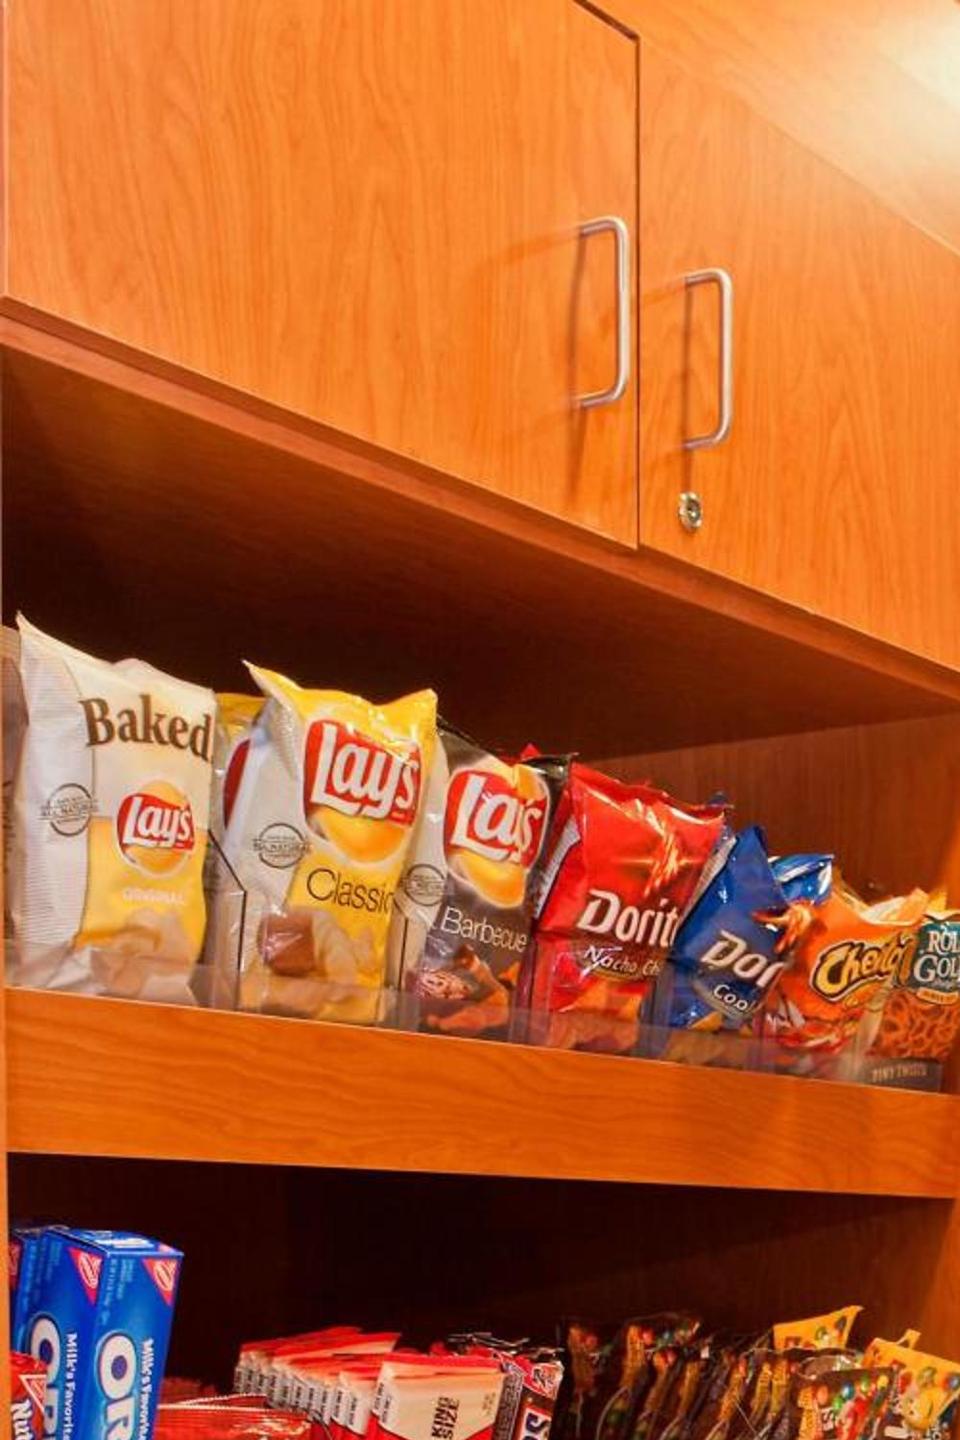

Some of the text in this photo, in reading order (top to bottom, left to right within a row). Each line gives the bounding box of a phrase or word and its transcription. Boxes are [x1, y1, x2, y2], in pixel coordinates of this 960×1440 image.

[79, 695, 213, 761] Baked
[311, 721, 420, 820] Lay's
[122, 797, 194, 850] Lay's
[306, 868, 397, 914] Classic
[441, 906, 529, 951] Barbecue
[431, 1396, 449, 1439] KING
[443, 1399, 461, 1440] SIZE
